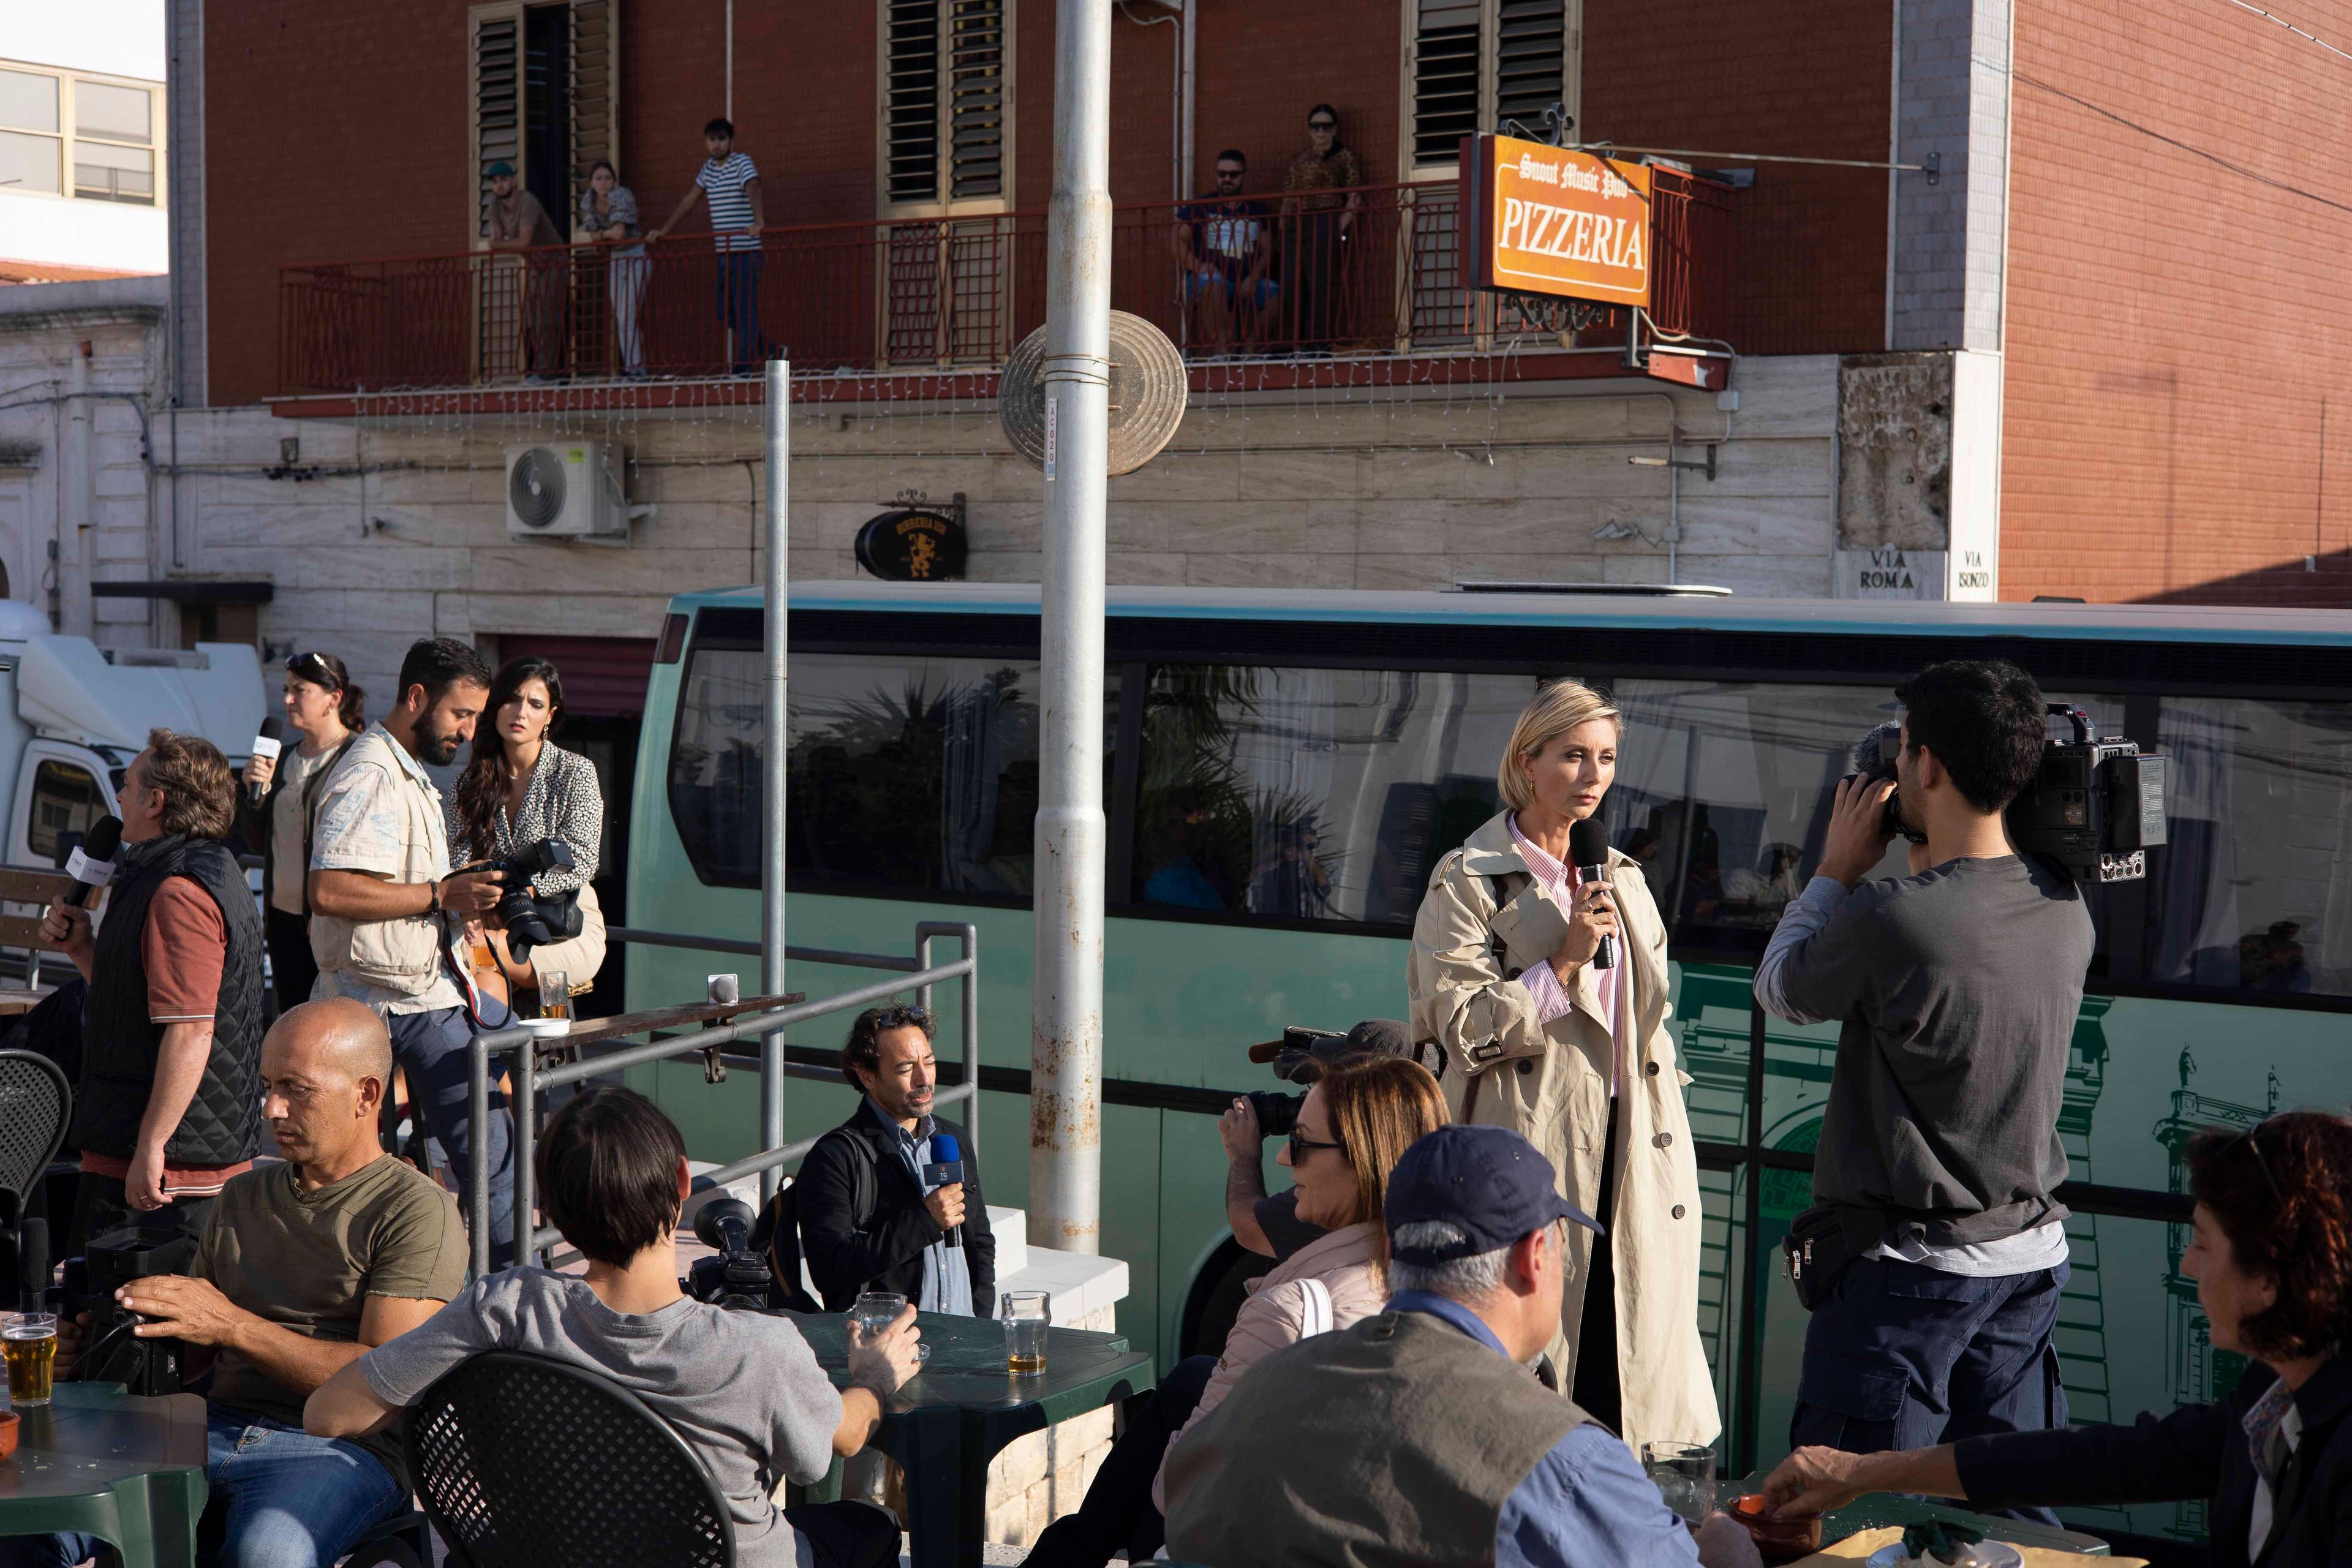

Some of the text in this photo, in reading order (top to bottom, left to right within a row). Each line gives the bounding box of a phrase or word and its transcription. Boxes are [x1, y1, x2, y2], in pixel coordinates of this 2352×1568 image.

[1519, 153, 1628, 200] Snout Music Pub
[1499, 197, 1645, 270] PIZZERIA
[1871, 551, 1906, 567] VIA
[1965, 551, 1981, 567] VIA
[1860, 571, 1913, 588] ROMA
[1959, 572, 1988, 588] ISONZO
